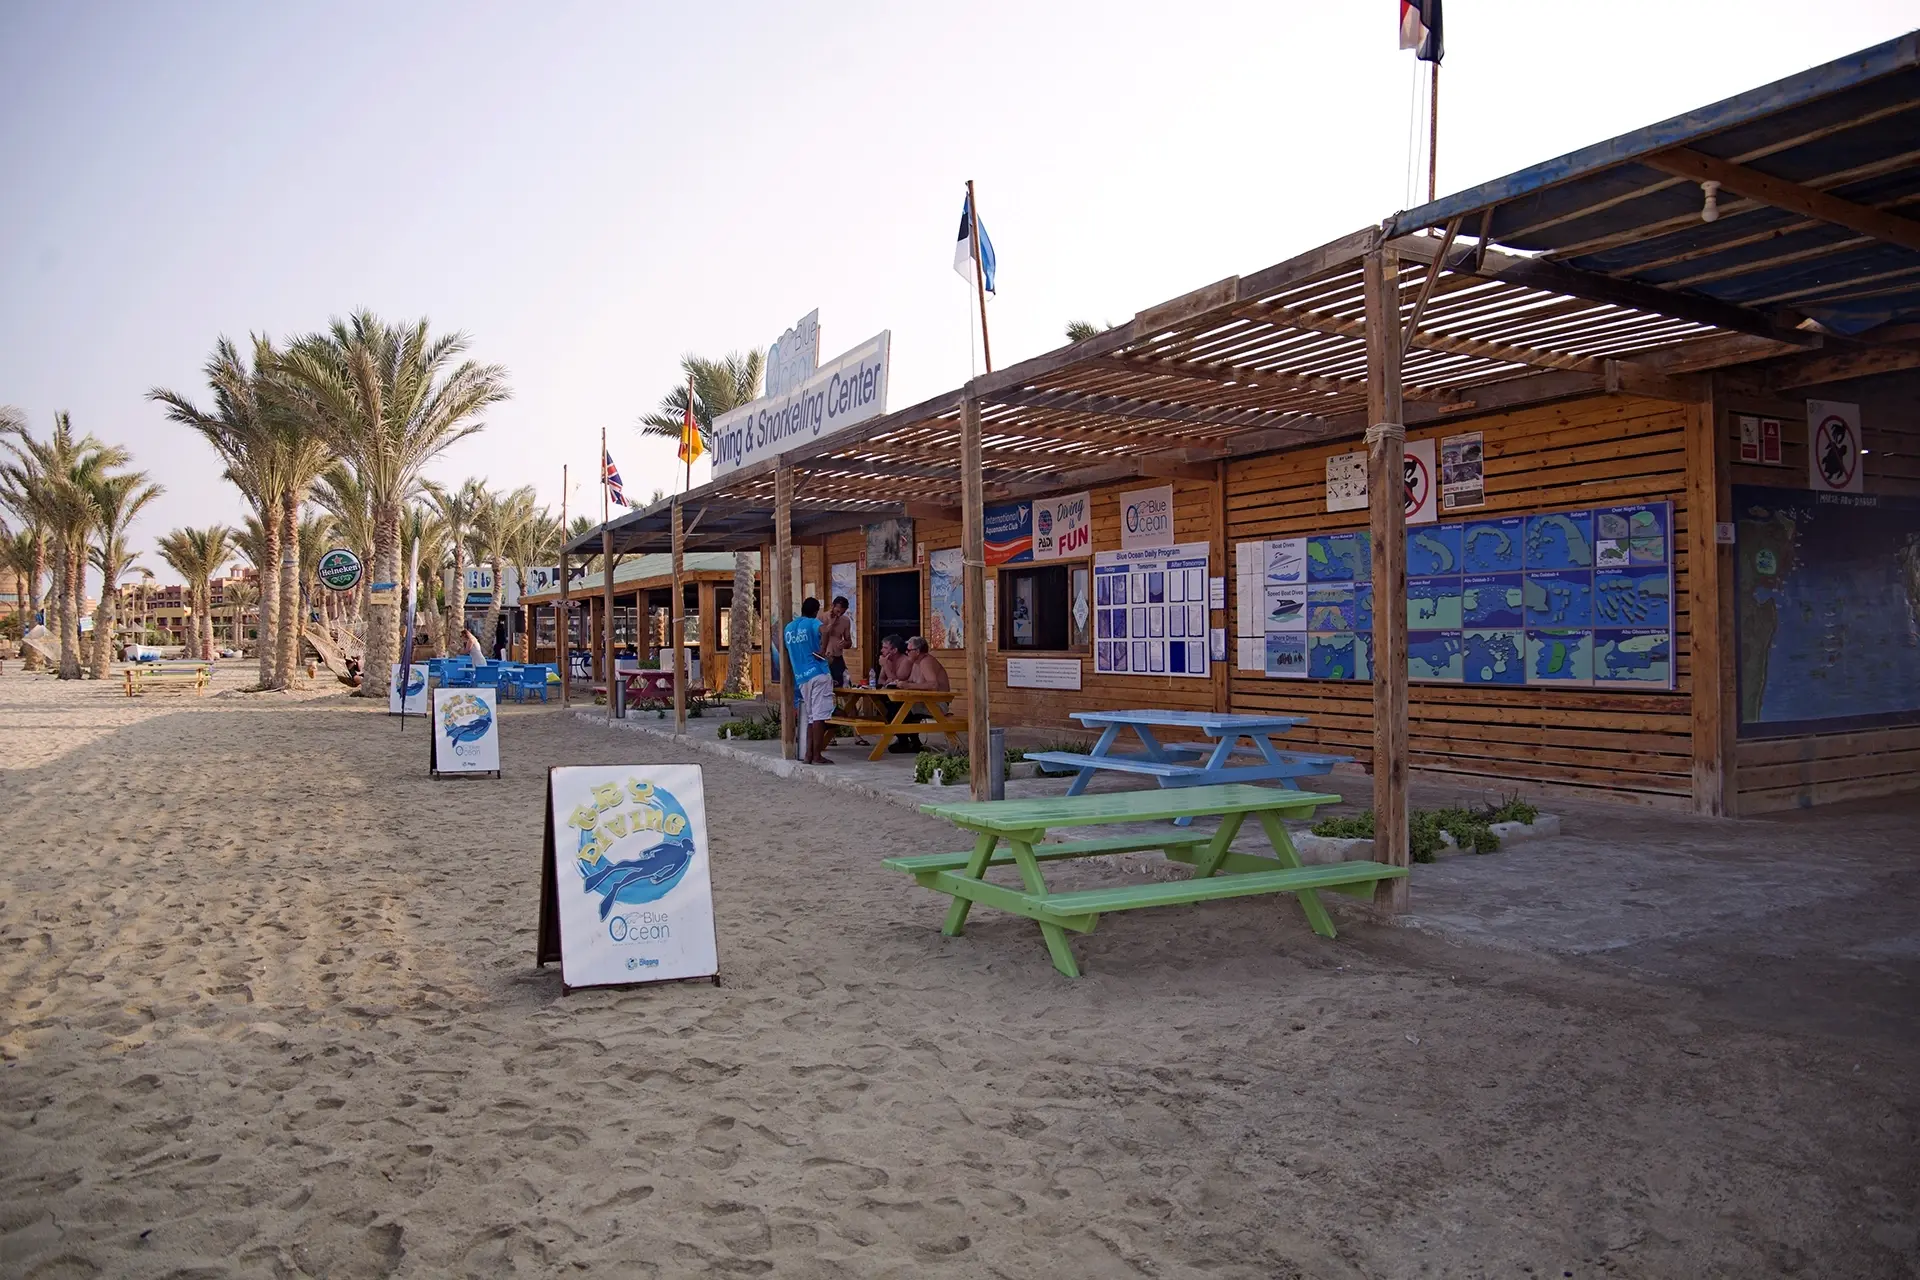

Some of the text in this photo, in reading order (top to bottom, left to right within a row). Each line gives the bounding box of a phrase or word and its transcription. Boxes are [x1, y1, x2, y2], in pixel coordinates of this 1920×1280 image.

[795, 321, 817, 352] Blue
[766, 343, 812, 402] Ocean
[712, 362, 881, 467] Diving & Snorkeling Center
[1057, 499, 1085, 522] Diving
[1148, 500, 1167, 514] Blue
[985, 512, 1019, 526] International
[1068, 518, 1075, 529] is
[1126, 505, 1168, 533] Ocean
[1008, 522, 1019, 531] Club
[1038, 537, 1053, 548] PADI
[1058, 524, 1088, 556] FUN
[1116, 548, 1181, 561] Blue Ocean Daily Program
[321, 563, 359, 577] Heineken
[1182, 560, 1206, 568] Tomorrow
[643, 911, 668, 924] Blue
[609, 916, 670, 941] Ocean
